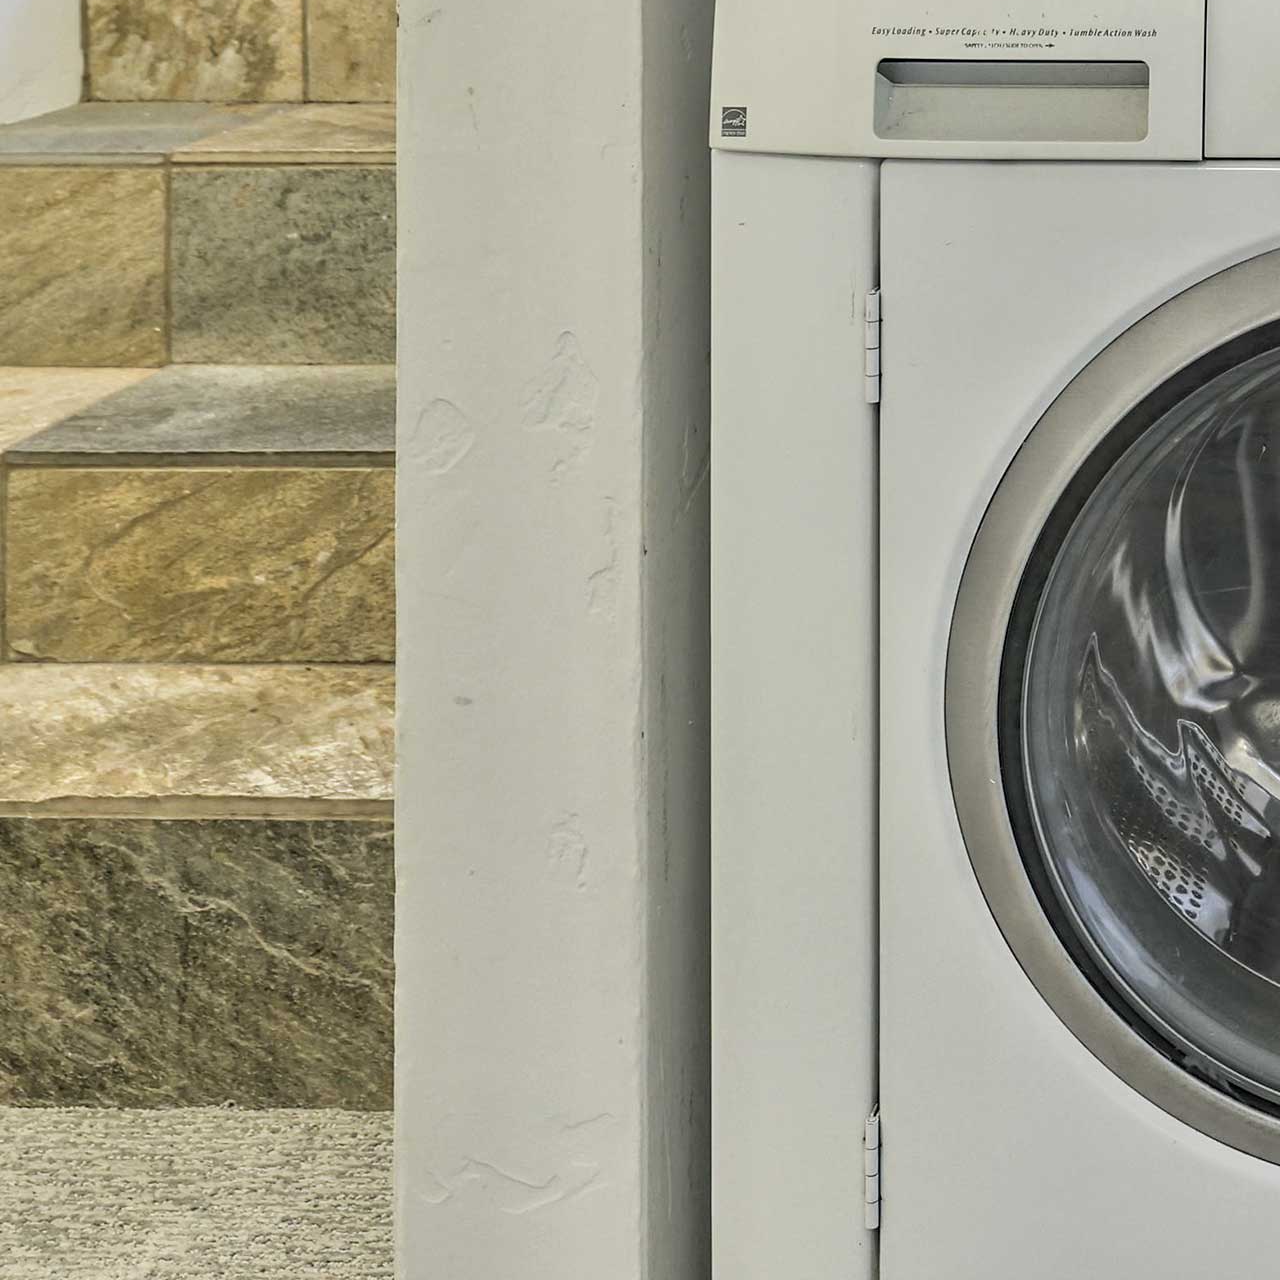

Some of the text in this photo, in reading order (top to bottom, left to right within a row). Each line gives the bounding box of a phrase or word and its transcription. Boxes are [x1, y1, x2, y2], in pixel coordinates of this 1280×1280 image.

[871, 26, 890, 37] Easy
[891, 26, 927, 37] Loading
[935, 26, 960, 37] Super
[1037, 28, 1059, 38] Duty
[1103, 28, 1132, 37] Action
[1134, 28, 1158, 37] Wash
